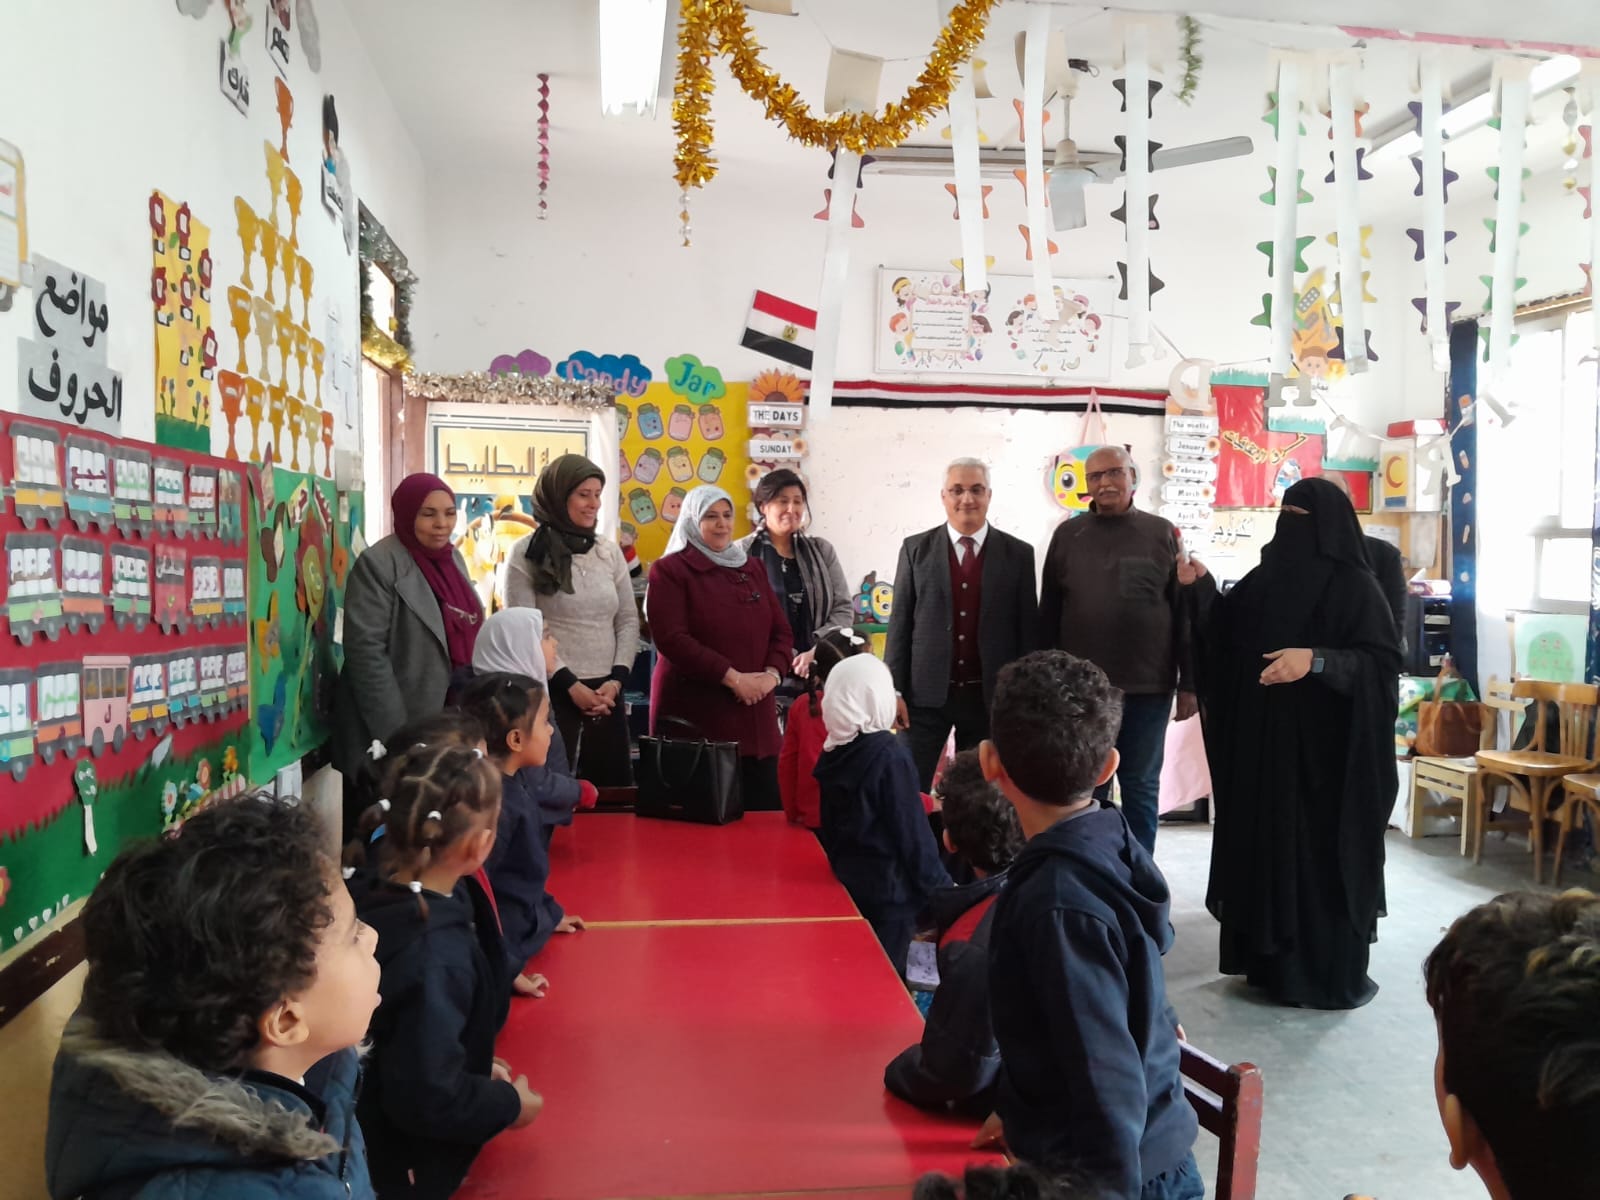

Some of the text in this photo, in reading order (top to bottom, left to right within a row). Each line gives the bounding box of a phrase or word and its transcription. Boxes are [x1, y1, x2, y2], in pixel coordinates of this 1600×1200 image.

[35, 271, 108, 348] مواضع
[28, 348, 122, 425] الحروف
[674, 361, 717, 397] Jar
[753, 409, 800, 422] THE DAYS
[759, 444, 792, 454] SUNDAY
